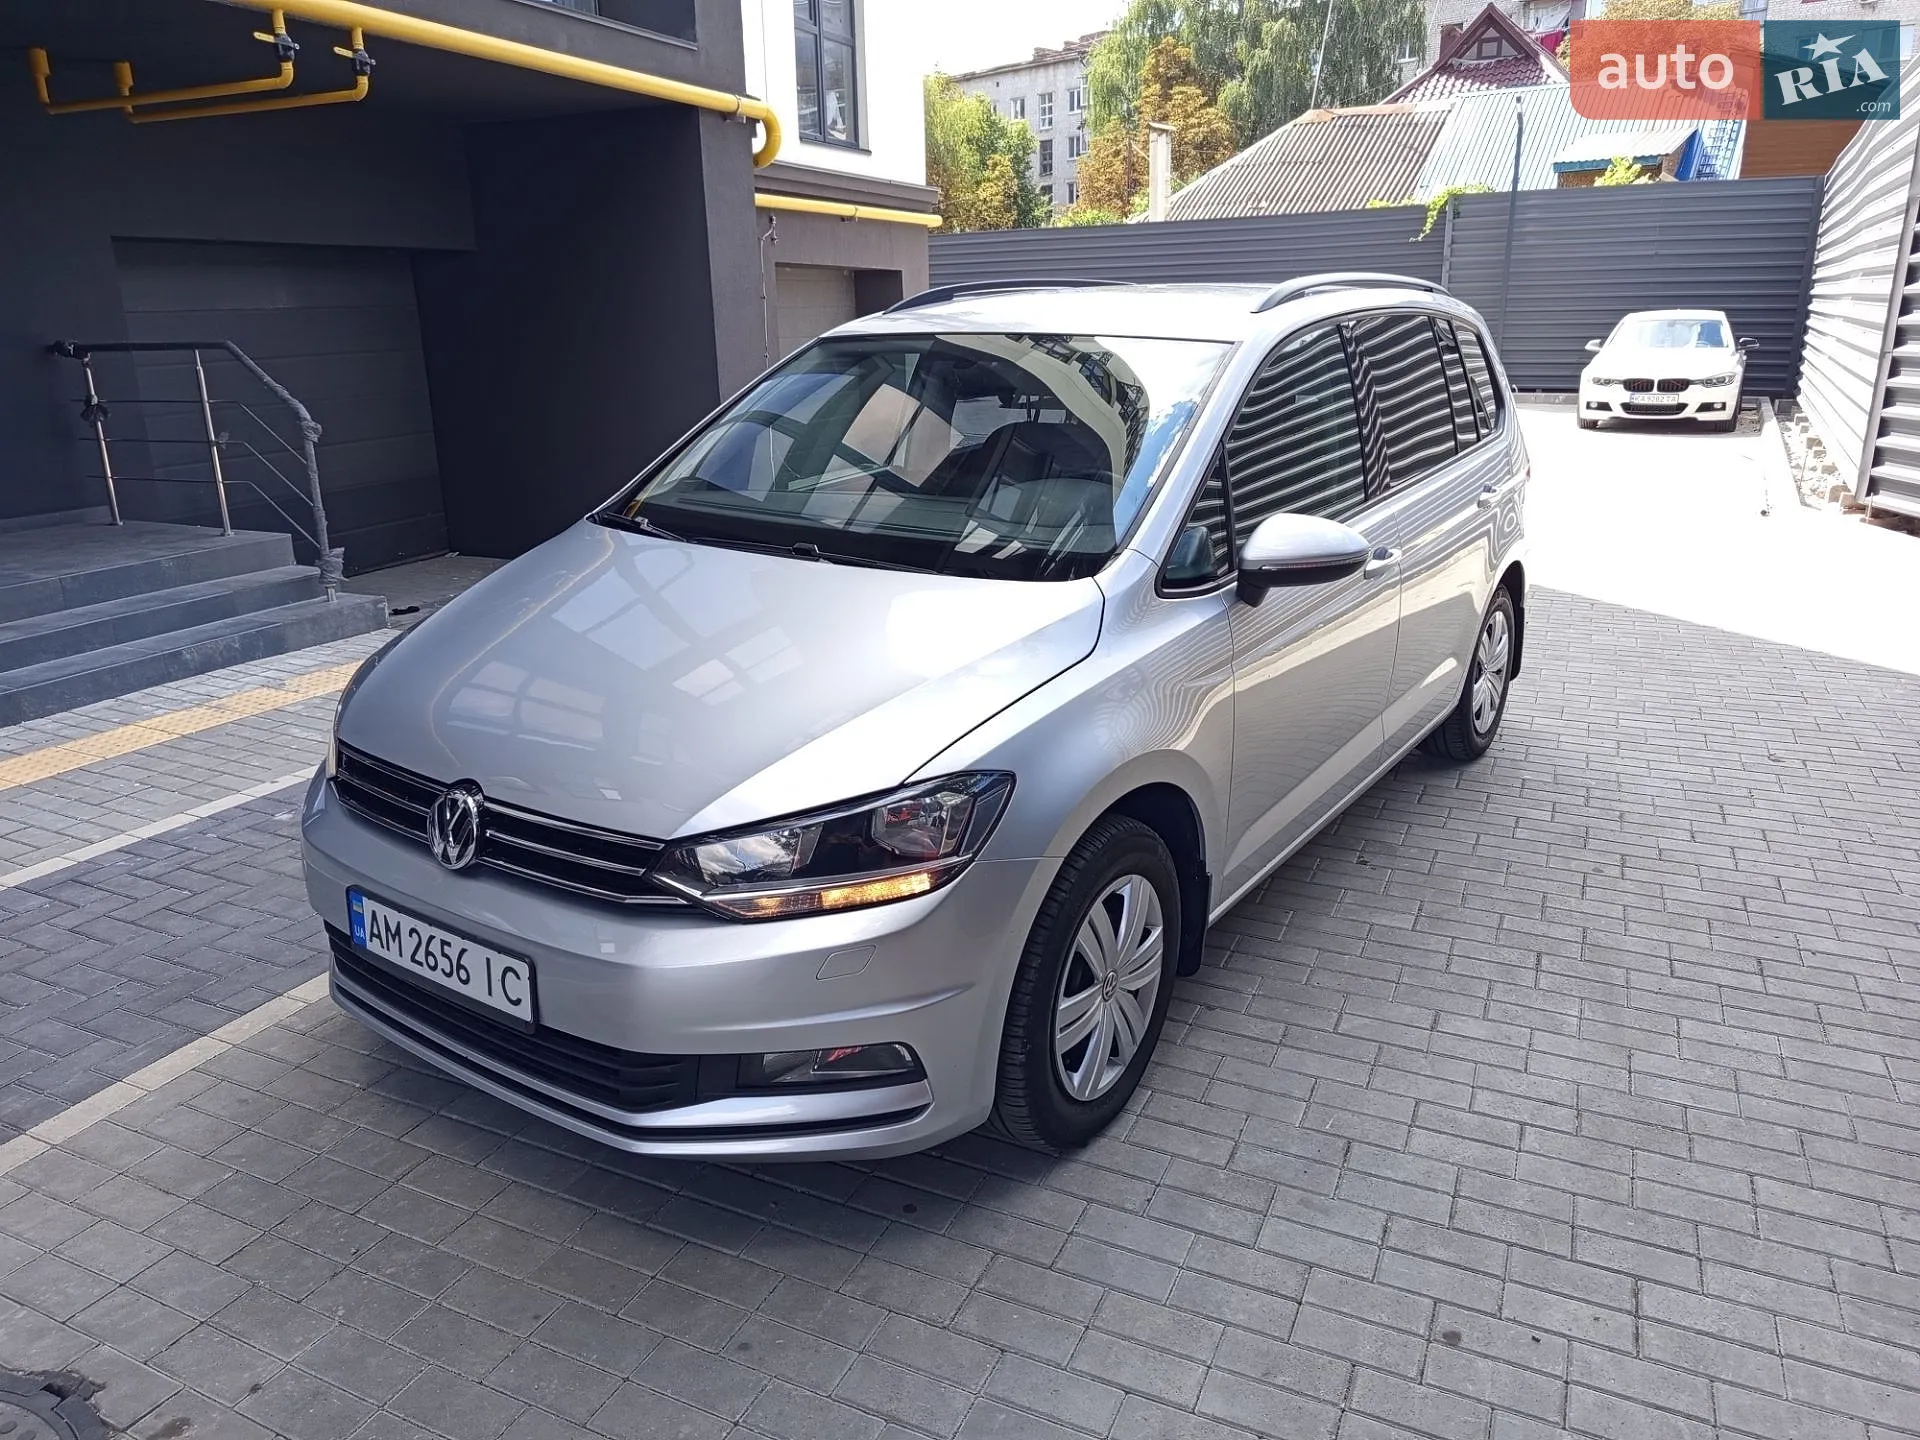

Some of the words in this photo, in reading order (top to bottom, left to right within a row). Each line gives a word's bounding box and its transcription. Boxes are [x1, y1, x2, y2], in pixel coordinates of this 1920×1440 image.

[354, 926, 366, 939] UA
[369, 910, 403, 958] AM
[408, 927, 471, 985] 2656
[485, 957, 522, 1006] IC
